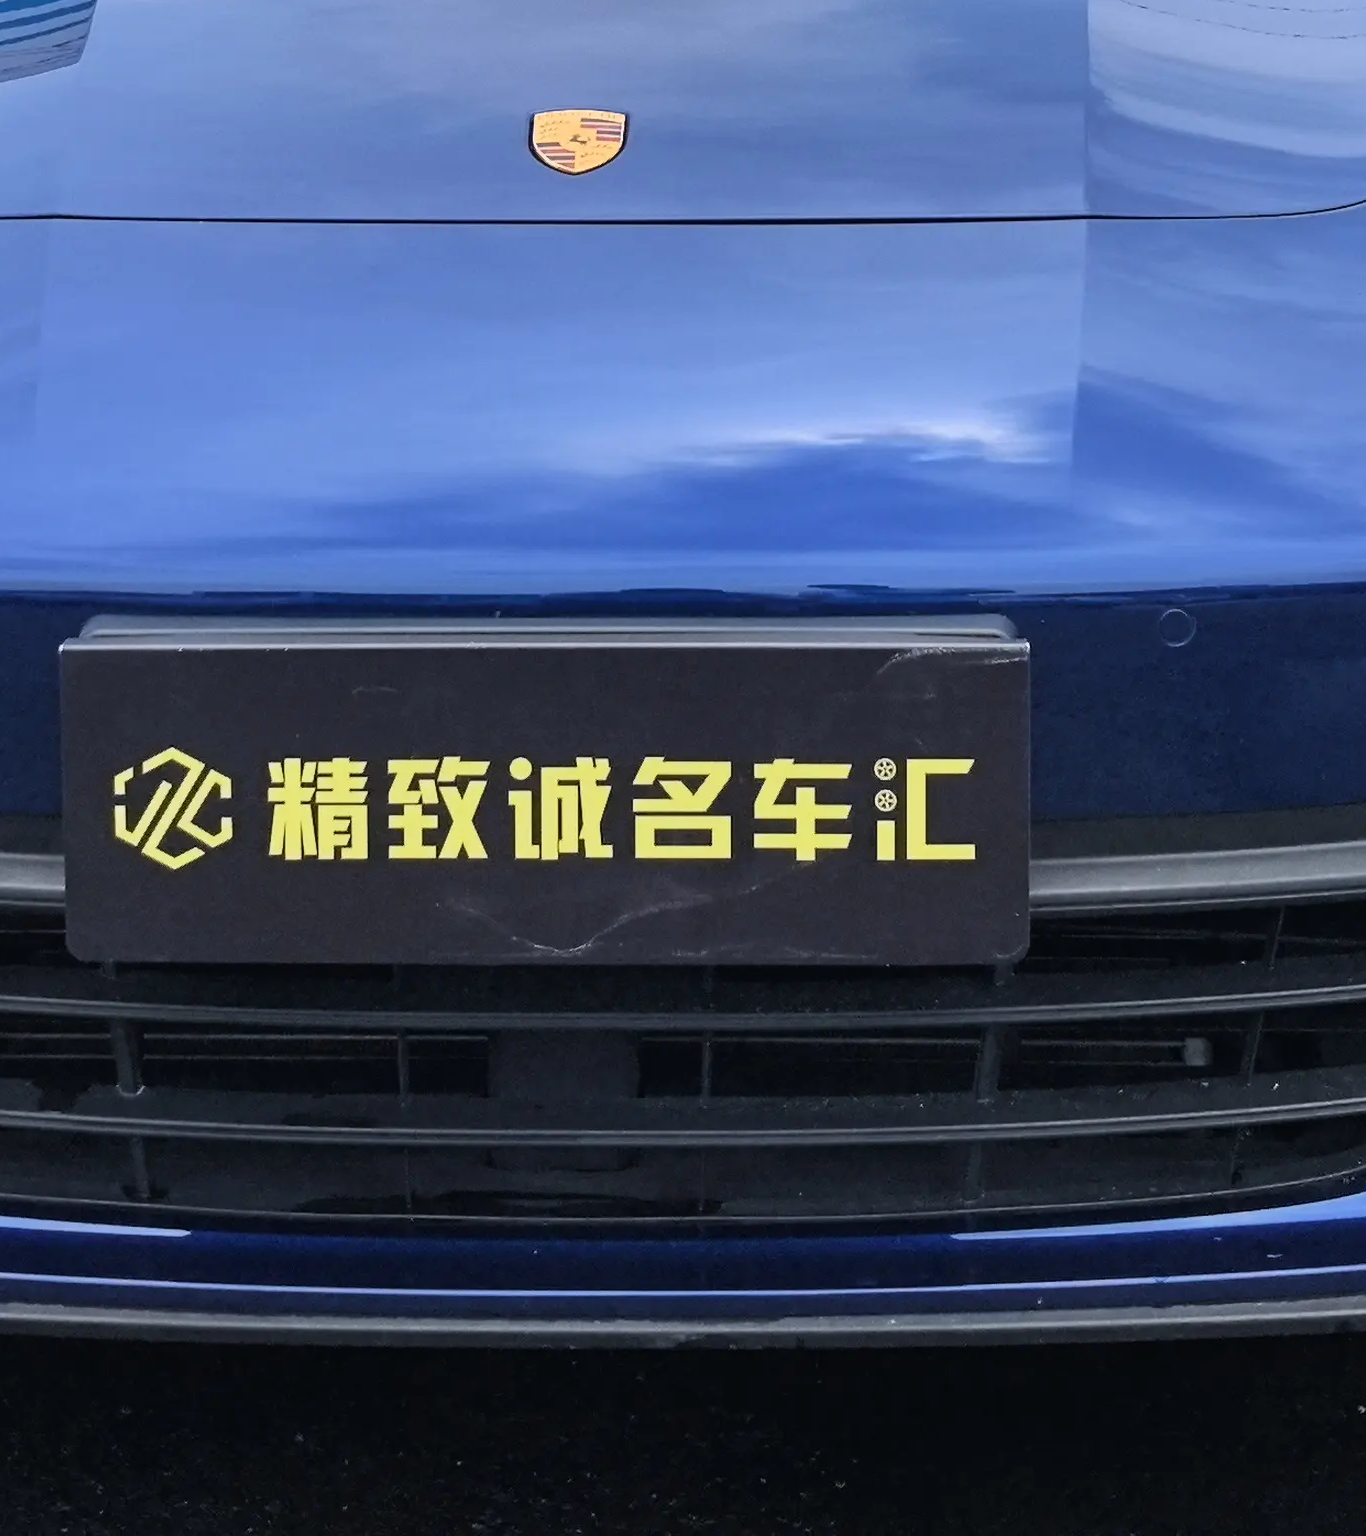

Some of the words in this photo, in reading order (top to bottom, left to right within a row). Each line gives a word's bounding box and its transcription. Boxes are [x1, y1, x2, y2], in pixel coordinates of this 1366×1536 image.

[267, 756, 978, 862] 精致诚名车汇
